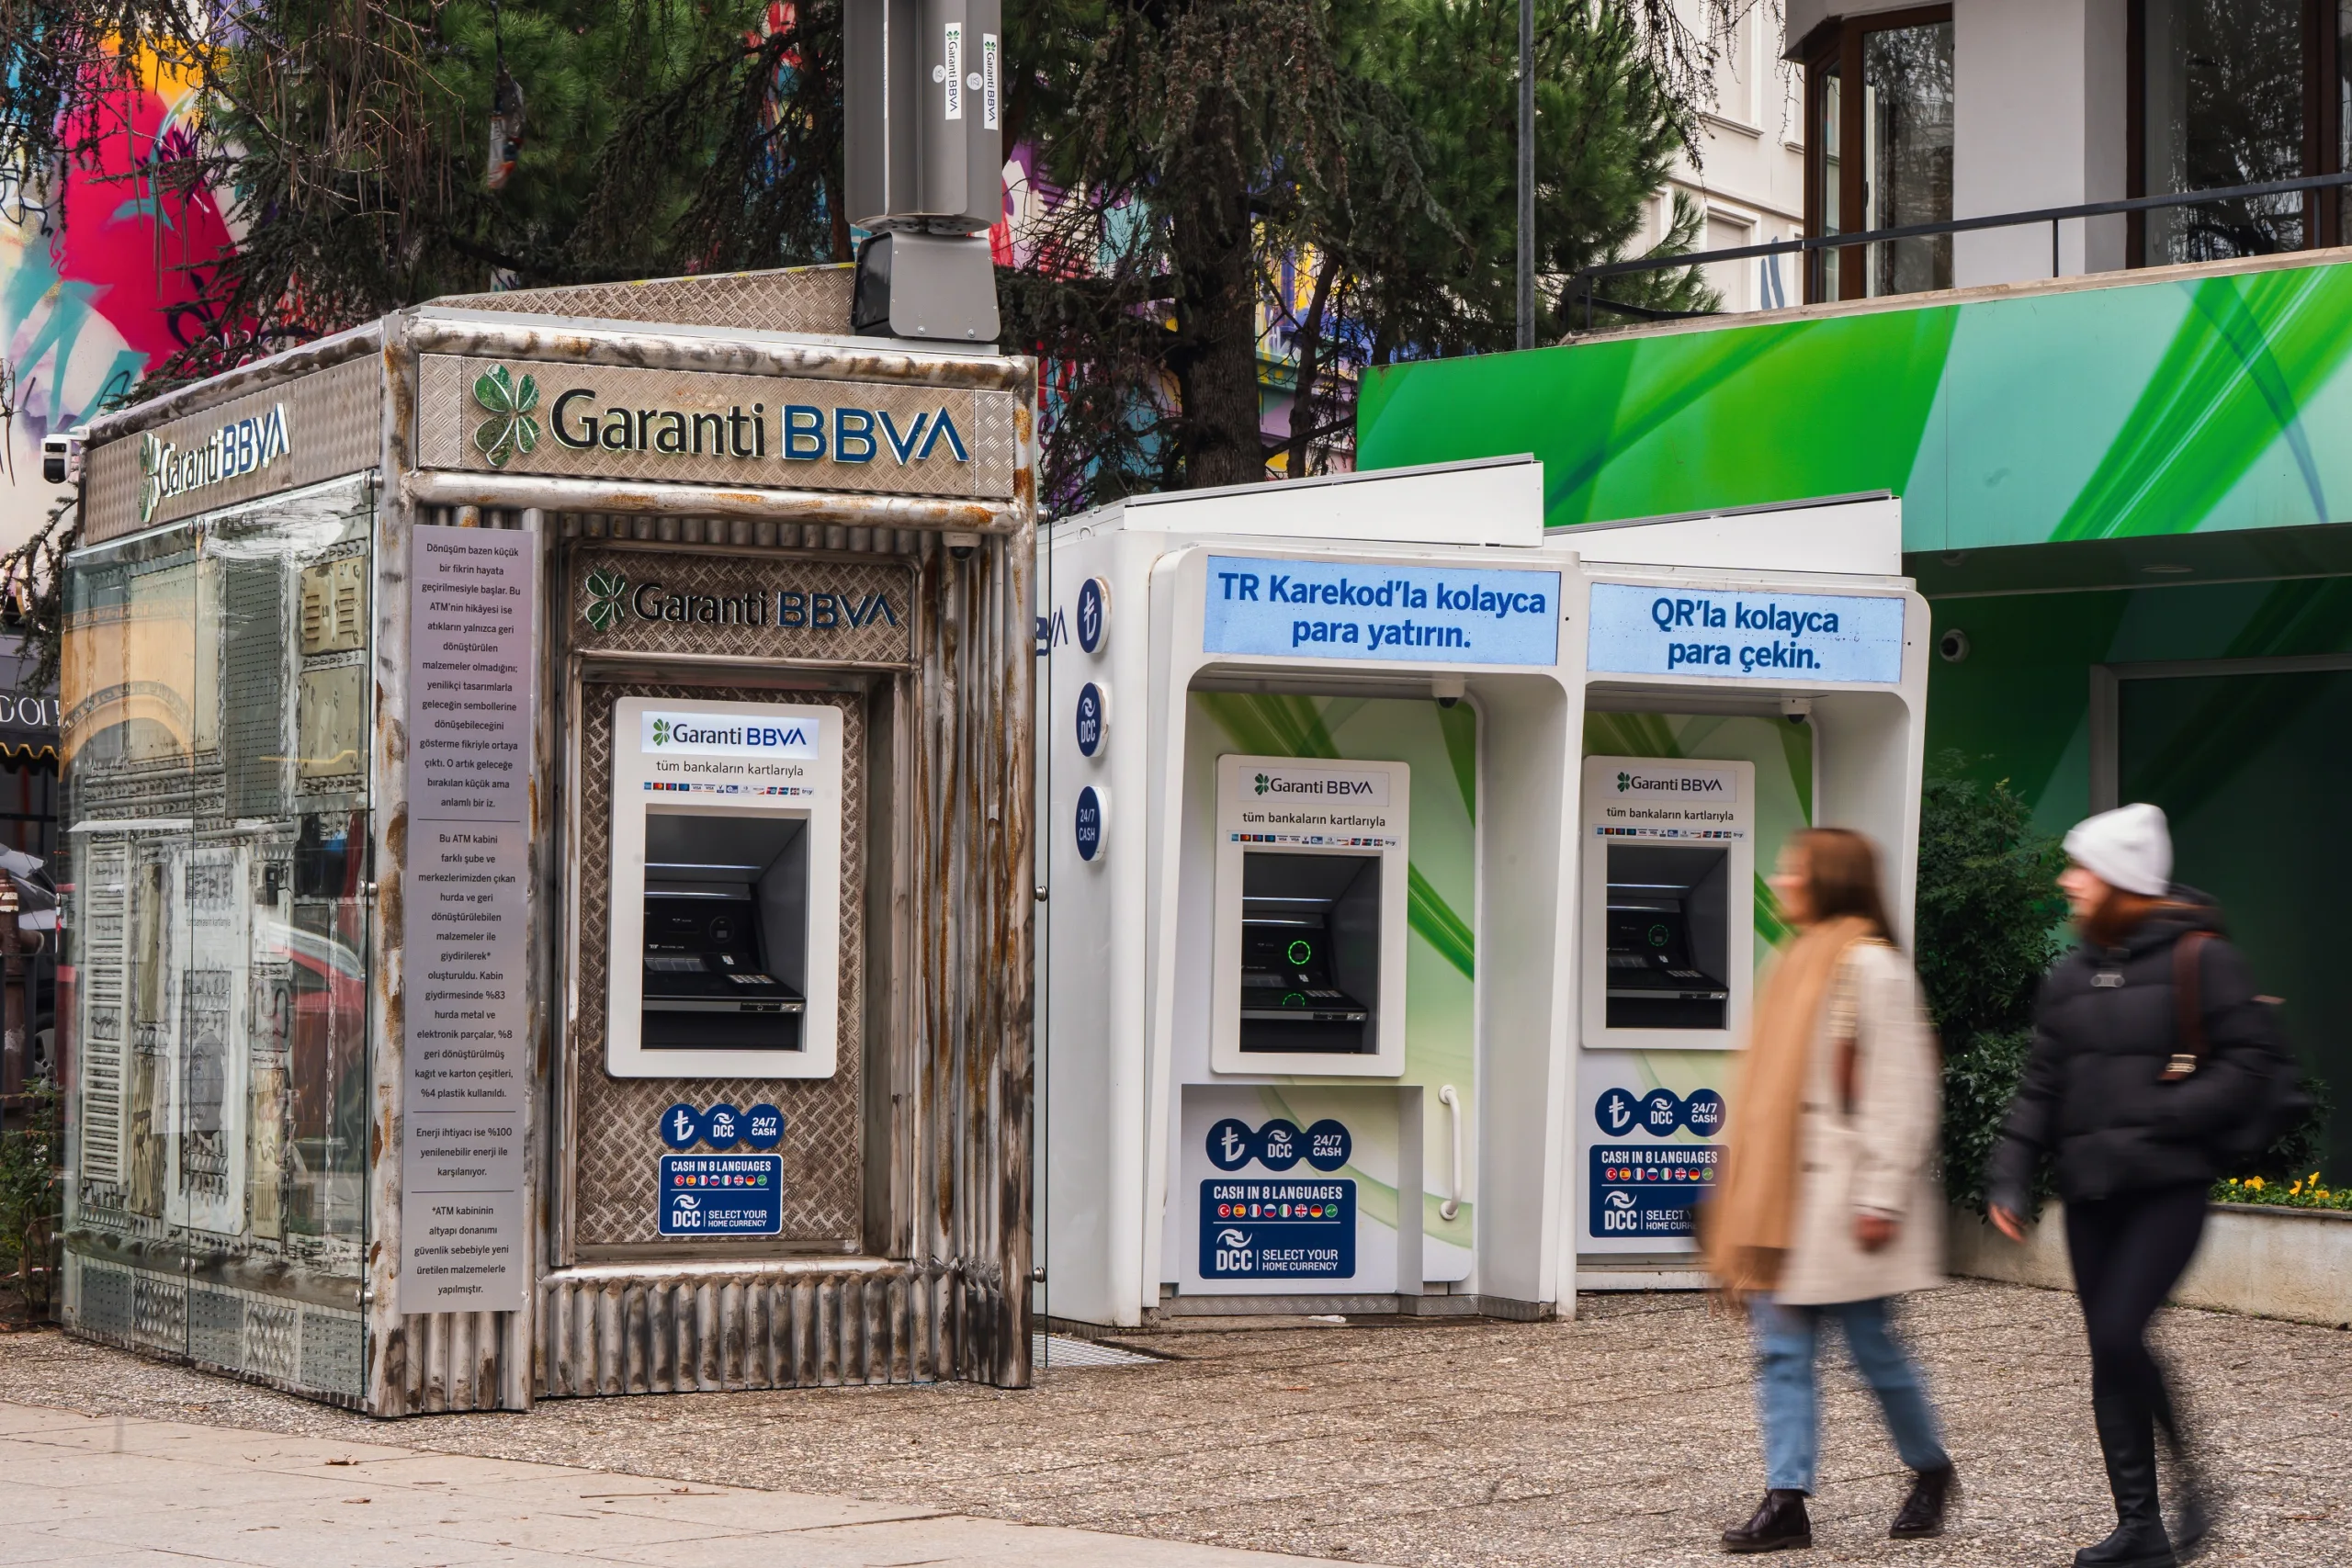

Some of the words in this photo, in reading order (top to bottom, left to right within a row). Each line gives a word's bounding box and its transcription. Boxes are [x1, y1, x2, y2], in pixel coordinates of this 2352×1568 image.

[948, 41, 957, 77] Garanti
[987, 51, 995, 88] Garanti
[948, 80, 957, 112] BBVA
[987, 90, 995, 121] BBVA
[549, 388, 764, 457] Garanti
[781, 404, 970, 466] BBVA
[159, 429, 222, 498] Garanti
[222, 402, 290, 479] BBVA
[427, 543, 466, 556] Dönüşüm
[469, 546, 492, 556] bazen
[494, 547, 518, 558] küçük
[439, 562, 451, 573] bir
[453, 563, 474, 574] fikrin
[476, 565, 503, 577] hayata
[422, 582, 479, 595] geçirilmesiyle
[509, 586, 520, 596] Bu
[1218, 572, 1260, 602] TR
[1270, 575, 1427, 609] Karekod'la
[1436, 582, 1546, 618] kolayca
[501, 604, 513, 615] ise
[632, 582, 766, 626] Garanti
[777, 591, 896, 629] BBVA
[1652, 598, 1727, 632] QR'la
[1735, 603, 1840, 637] kolayca
[427, 621, 461, 632] atıkların
[463, 623, 496, 634] yalnızca
[498, 626, 514, 636] geri
[1292, 620, 1360, 649] para
[1367, 621, 1472, 651] yatırın.
[443, 641, 498, 654] dönüştürülen
[1668, 640, 1734, 669] para
[1741, 642, 1822, 673] çekin.
[423, 660, 470, 671] malzemeler
[472, 661, 517, 674] olmadığını;
[427, 680, 461, 692] yenilikçi
[463, 682, 512, 692] tasarımlarla
[423, 699, 461, 712] geleceğin
[464, 701, 516, 712] sembollerine
[673, 723, 741, 745] Garanti
[746, 728, 807, 746] BBVA
[1080, 719, 1096, 743] DCC
[420, 739, 459, 750] gösterme
[461, 739, 490, 751] fikriyle
[492, 740, 517, 752] ortaya
[447, 758, 454, 768] O
[456, 760, 474, 769] artık
[477, 759, 513, 772] geleceğe
[656, 761, 680, 772] tüm
[684, 761, 744, 774] bankaların
[748, 763, 804, 779] kartlarıyla
[427, 777, 463, 787] bırakılan
[465, 778, 490, 790] küçük
[492, 781, 509, 789] ama
[1271, 778, 1323, 794] Garanti
[1327, 781, 1373, 795] BBVA
[1631, 776, 1678, 791] Garanti
[1681, 779, 1723, 792] BBVA
[441, 797, 470, 807] anlamlı
[473, 797, 484, 807] bir
[1080, 808, 1095, 823] 24/7
[1242, 812, 1264, 822] tüm
[1268, 812, 1327, 825] bankaların
[1330, 814, 1385, 829] kartlarıyla
[1607, 807, 1626, 818] tüm
[1629, 808, 1681, 819] bankaların
[1684, 810, 1734, 823] kartlarıyla
[439, 833, 450, 843] Bu
[453, 833, 470, 844] ATM
[473, 834, 498, 844] kabini
[1079, 827, 1095, 841] CASH
[441, 852, 462, 863] farklı
[464, 853, 484, 865] şube
[419, 873, 492, 883] merkezlerimizden
[493, 874, 515, 885] çıkan
[440, 892, 464, 901] hurda
[477, 893, 493, 905] geri
[432, 911, 502, 923] dönüştürülebilen
[436, 931, 484, 942] malzemeler
[487, 931, 496, 942] ile
[480, 971, 503, 980] Kabin
[425, 989, 483, 1001] giydirmesinde
[486, 990, 505, 1000] %83
[435, 1010, 458, 1019] hurda
[461, 1010, 484, 1020] metal
[417, 1029, 458, 1039] elektronik
[498, 1030, 513, 1039] %8
[424, 1049, 440, 1060] geri
[442, 1048, 504, 1061] dönüştürülmüş
[415, 1068, 435, 1080] kağıt
[449, 1068, 476, 1078] karton
[421, 1088, 435, 1097] %4
[437, 1088, 466, 1100] plastik
[1691, 1103, 1717, 1113] 24/7
[752, 1117, 776, 1127] 24/7
[1650, 1111, 1673, 1124] DCC
[1691, 1114, 1717, 1122] CASH
[416, 1128, 440, 1140] Enerji
[442, 1128, 471, 1139] ihtiyacı
[474, 1127, 486, 1136] ise
[488, 1126, 512, 1136] %100
[713, 1125, 734, 1137] DCC
[1313, 1135, 1341, 1145] 24/7
[421, 1146, 471, 1159] yenilenebilir
[473, 1146, 496, 1158] enerji
[498, 1146, 507, 1156] ile
[1267, 1144, 1292, 1157] DCC
[1313, 1147, 1341, 1156] CASH
[1601, 1151, 1629, 1163] CASH
[1632, 1151, 1643, 1163] IN
[1645, 1151, 1653, 1163] 8
[1655, 1151, 1718, 1163] LANGUAGES
[671, 1161, 695, 1171] CASH
[697, 1161, 707, 1171] IN
[709, 1161, 716, 1171] 8
[717, 1160, 771, 1171] LANGUAGES
[1214, 1186, 1244, 1199] CASH
[1248, 1186, 1259, 1199] IN
[1262, 1186, 1270, 1199] 8
[1272, 1186, 1342, 1199] LANGUAGES
[673, 1211, 701, 1227] DCC
[708, 1210, 741, 1219] SELECT
[743, 1210, 767, 1218] YOUR
[414, 1246, 448, 1258] güvenlik
[451, 1245, 490, 1257] sebebiyle
[492, 1245, 509, 1256] yeni
[1262, 1249, 1305, 1259] SELECT
[1307, 1249, 1338, 1259] YOUR
[1216, 1249, 1252, 1270] DCC
[1262, 1262, 1287, 1270] HOME
[1290, 1262, 1338, 1270] CURRENCY
[417, 1265, 448, 1275] üretilen
[450, 1264, 505, 1274] malzemelerle
